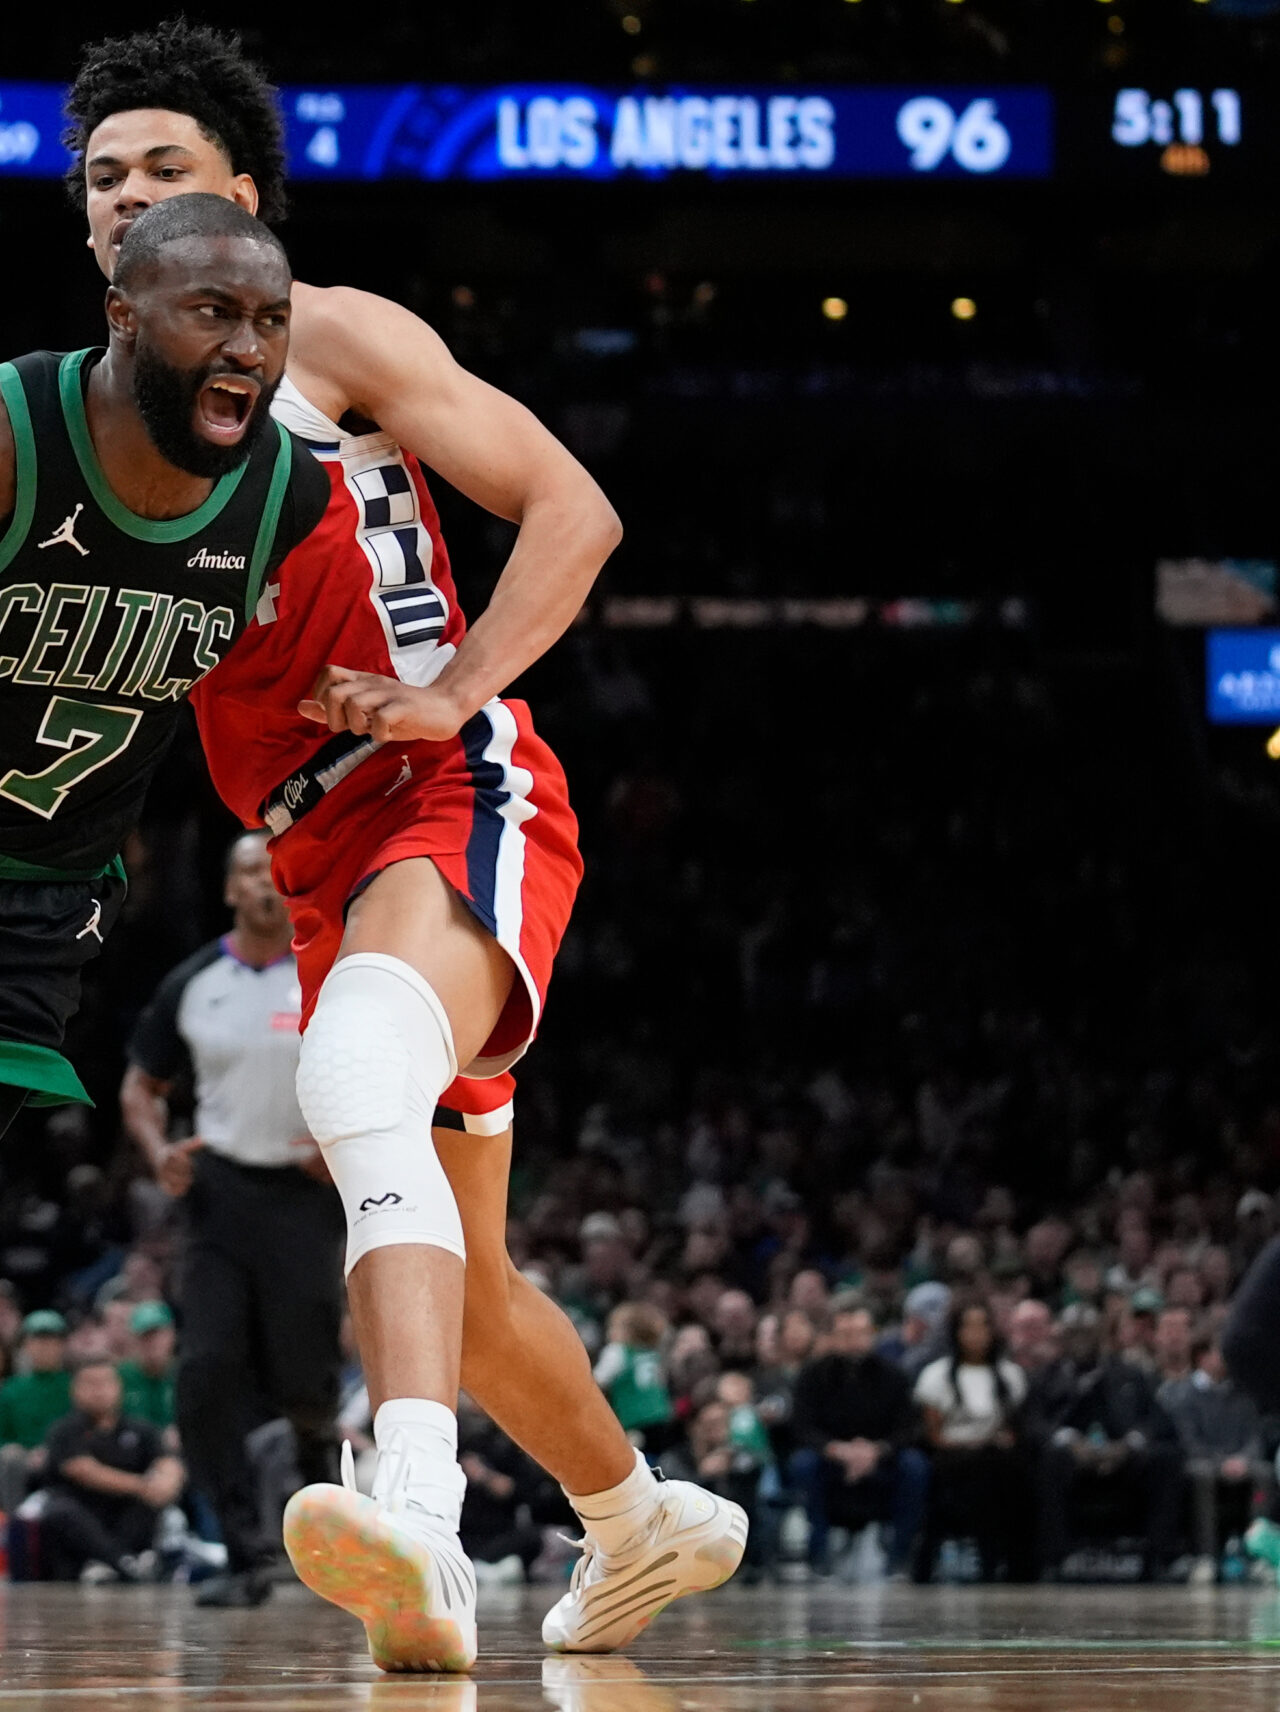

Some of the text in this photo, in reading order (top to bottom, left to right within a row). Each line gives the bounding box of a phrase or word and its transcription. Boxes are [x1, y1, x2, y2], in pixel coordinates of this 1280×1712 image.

[497, 95, 835, 170] LOS ANGELES
[896, 96, 1011, 172] 96
[1113, 87, 1241, 147] 5:11
[186, 547, 246, 570] Amica
[283, 773, 309, 809] Clips
